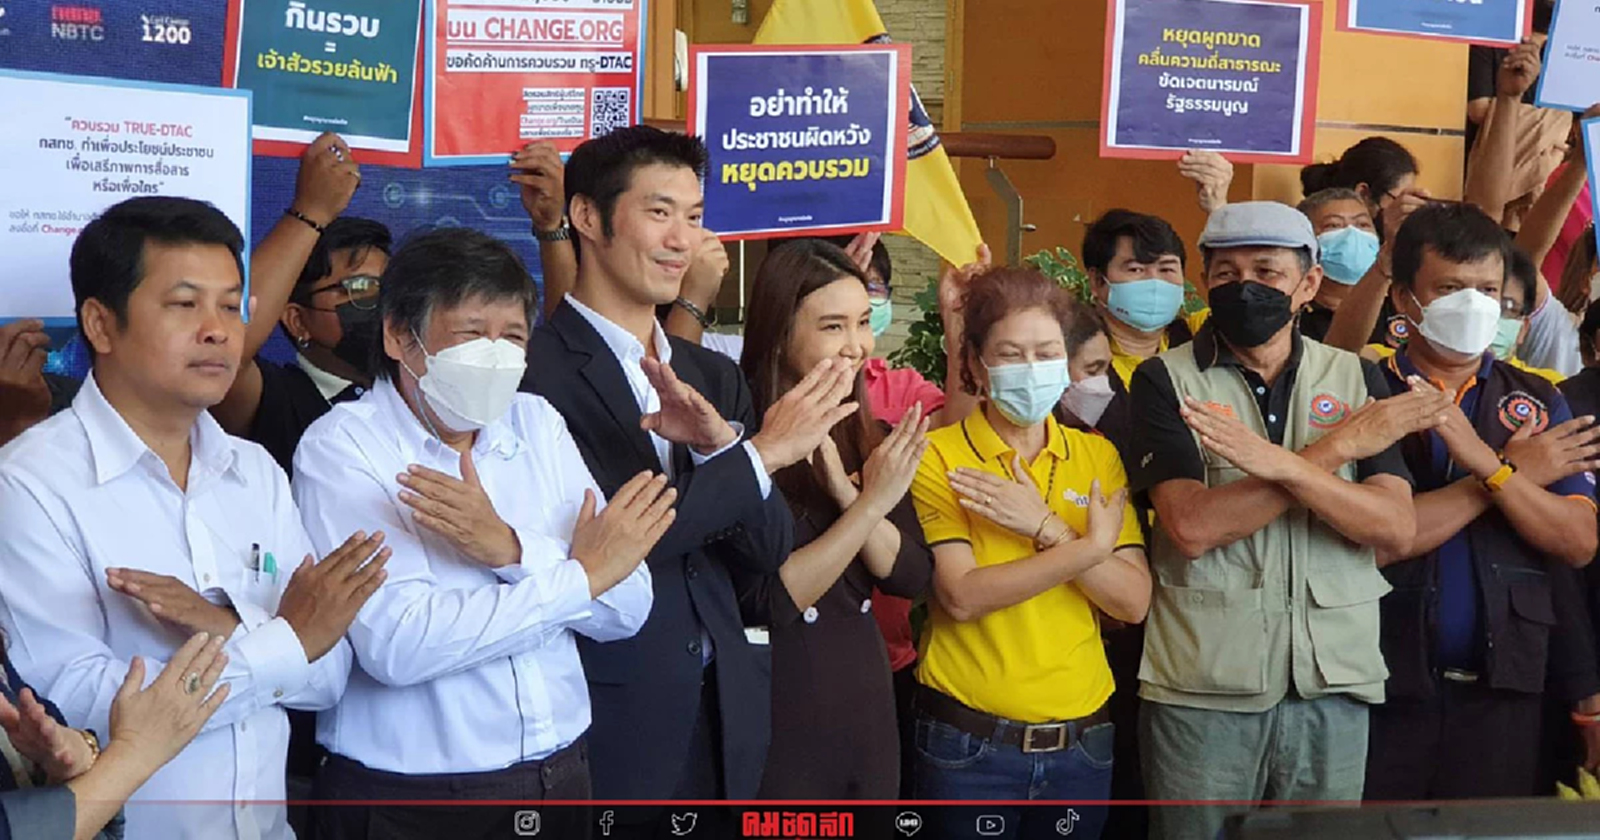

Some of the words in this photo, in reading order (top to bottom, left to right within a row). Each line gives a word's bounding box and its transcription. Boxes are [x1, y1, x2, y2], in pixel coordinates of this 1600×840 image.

[286, 1, 380, 38] กินรวบ
[448, 20, 476, 37] บน
[484, 17, 622, 41] CHANGE.ORG
[52, 23, 104, 40] NBTC
[142, 25, 191, 44] 1200
[1163, 28, 1261, 49] หยุดผูกขาด
[257, 49, 398, 83] เจ้าสัวรวยล้นฟ้า
[447, 53, 576, 69] ขอคัดค้านการควบรวม
[580, 56, 632, 73] ทรู-DTAC
[1139, 47, 1281, 72] คลื่นความถี่สาธารณะ
[1159, 72, 1260, 92] ขัดเจตนารมณ์
[750, 87, 849, 116] อย่าทำให้
[1166, 94, 1248, 116] รัฐธรรมนูญ
[124, 121, 193, 138] TRUE-DTAC
[722, 123, 871, 150] ประชาชนผิดหวัง
[82, 136, 214, 158] ทำเพื่อประโยชน์ประชาชน
[66, 153, 190, 176] เพื่อเสรีภาพการสื่อสาร
[722, 157, 870, 191] หยุดควบรวม
